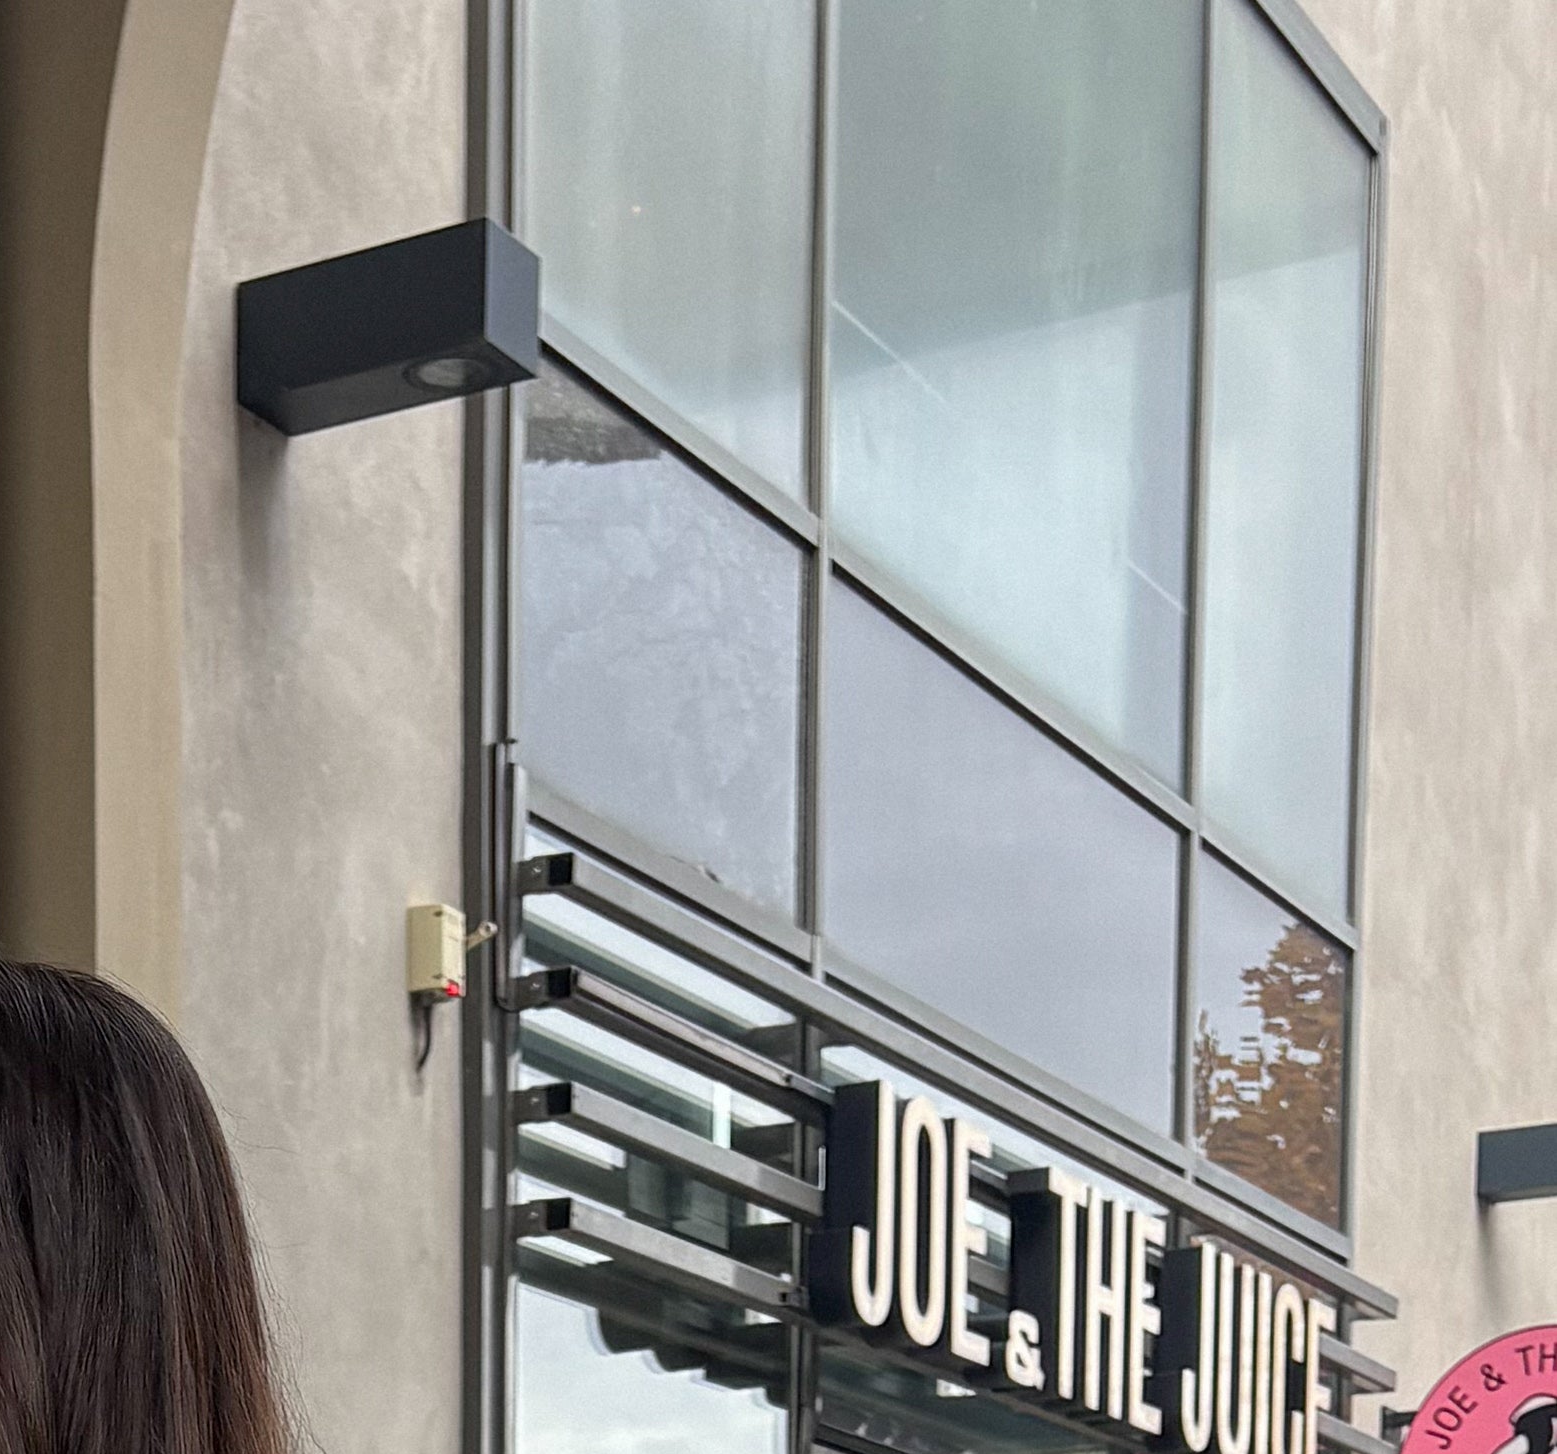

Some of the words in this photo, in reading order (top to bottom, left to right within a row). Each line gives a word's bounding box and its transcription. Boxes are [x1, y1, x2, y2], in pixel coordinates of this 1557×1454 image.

[852, 1079, 993, 1367] JOE
[1005, 1309, 1045, 1391] &
[1048, 1166, 1169, 1436] THE
[1425, 1385, 1478, 1450] JOE
[1480, 1363, 1507, 1392] &
